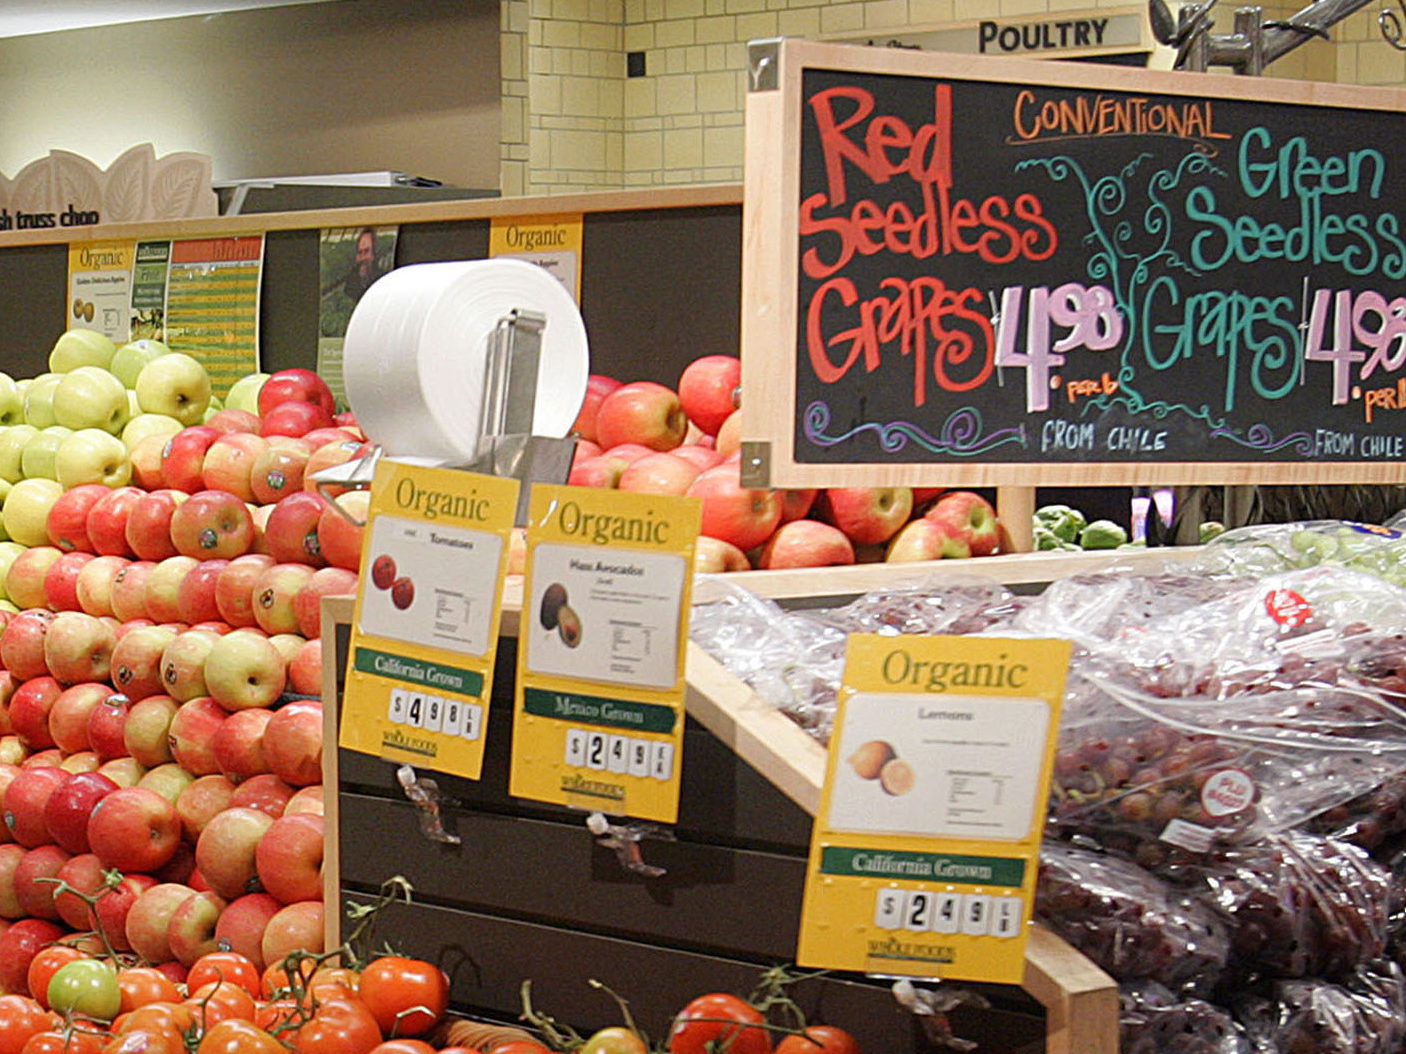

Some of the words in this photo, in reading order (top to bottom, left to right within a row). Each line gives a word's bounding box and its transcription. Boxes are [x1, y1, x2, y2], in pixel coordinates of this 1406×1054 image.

[979, 18, 1108, 54] POULTRY
[1014, 89, 1232, 139] CONVENTIONAL
[807, 83, 953, 208] Red
[1239, 126, 1385, 199] Green
[16, 210, 55, 229] truss
[506, 223, 567, 251] Organic
[799, 178, 1058, 279] Seedless
[1185, 185, 1406, 279] Seedless
[80, 246, 123, 270] Organic
[806, 276, 995, 407] Grapes
[1142, 277, 1302, 412] Grapes
[1041, 419, 1094, 453] FROM
[1107, 425, 1168, 453] CHILE
[1315, 429, 1354, 457] FROM
[1360, 435, 1404, 457] CHILE
[396, 477, 491, 522] Organic
[559, 501, 670, 545] Organic
[375, 655, 425, 680] California
[426, 667, 462, 688] Grown
[882, 649, 1029, 693] Organic
[852, 853, 932, 875] California
[934, 858, 992, 879] Grown
